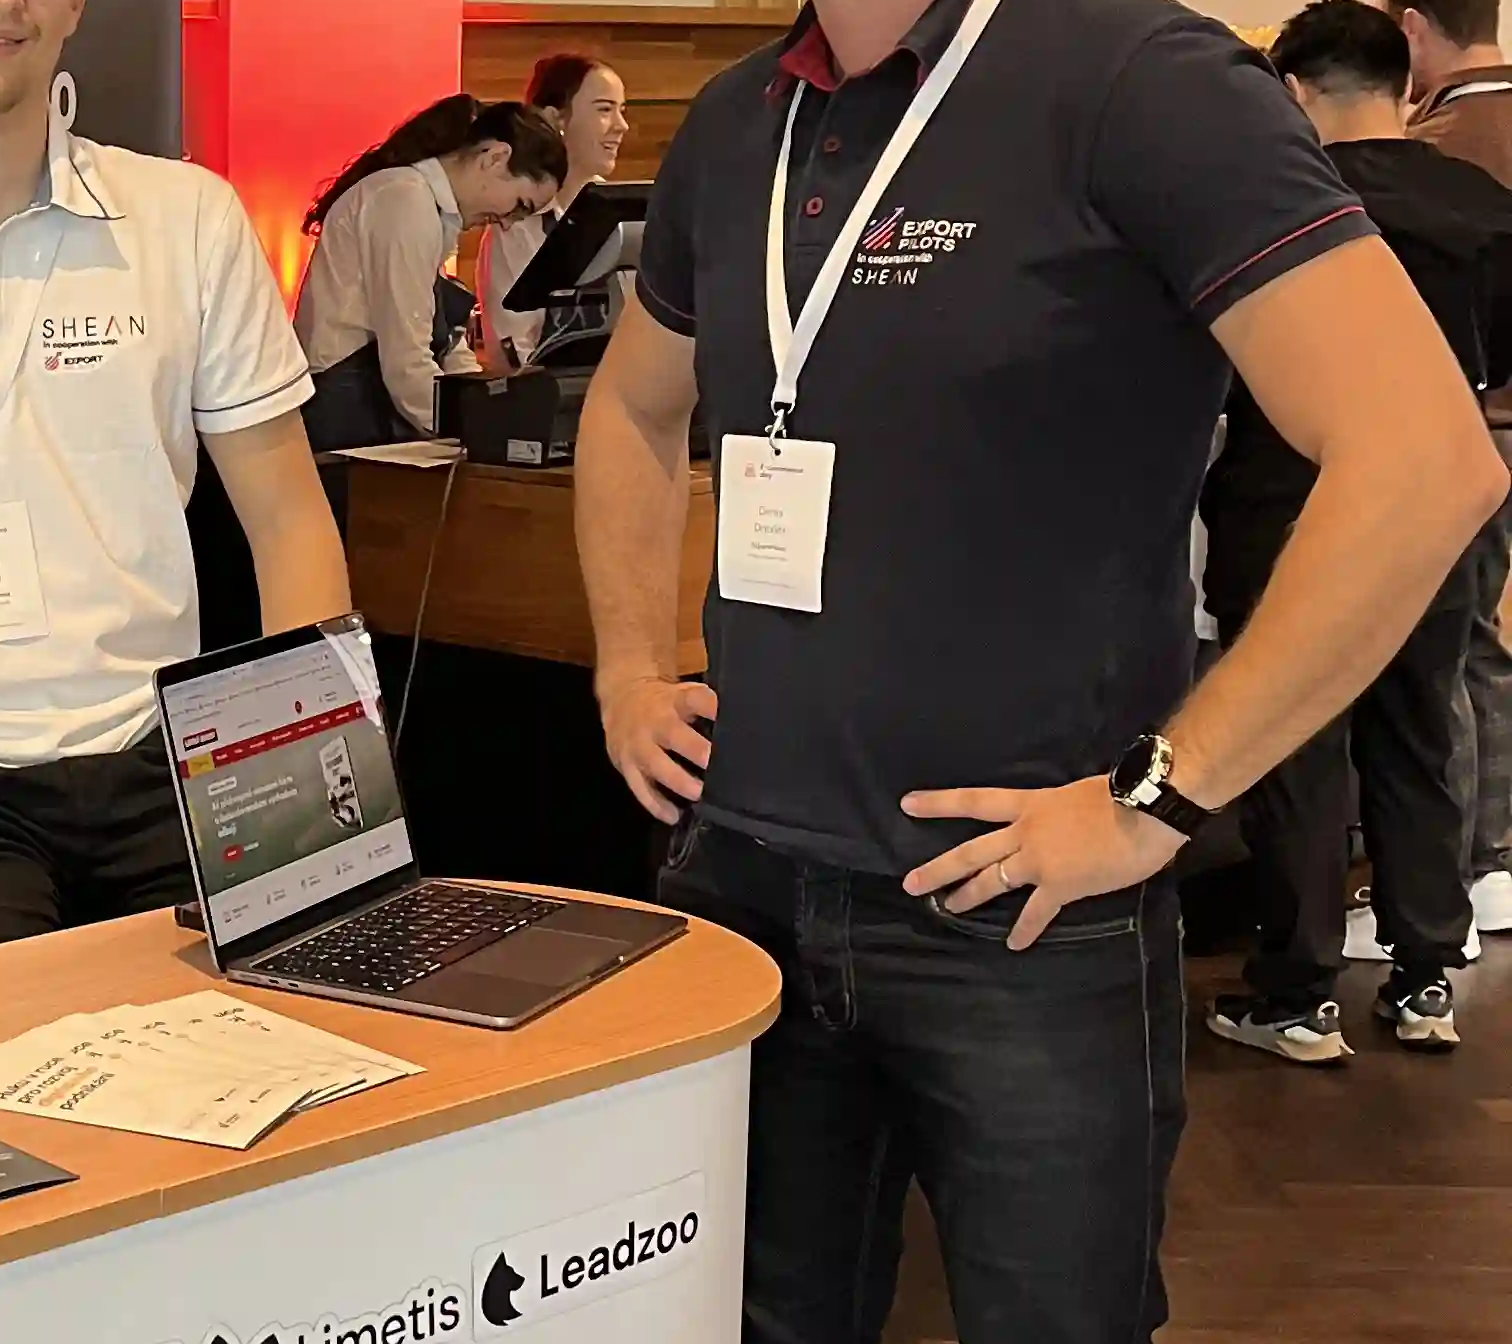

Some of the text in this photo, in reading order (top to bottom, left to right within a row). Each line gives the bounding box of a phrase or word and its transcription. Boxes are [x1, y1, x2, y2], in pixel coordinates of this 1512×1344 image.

[902, 219, 977, 238] EXPORT
[896, 236, 956, 252] PILOTS
[64, 355, 104, 365] EXPORT
[540, 1211, 700, 1300] Leadzoo
